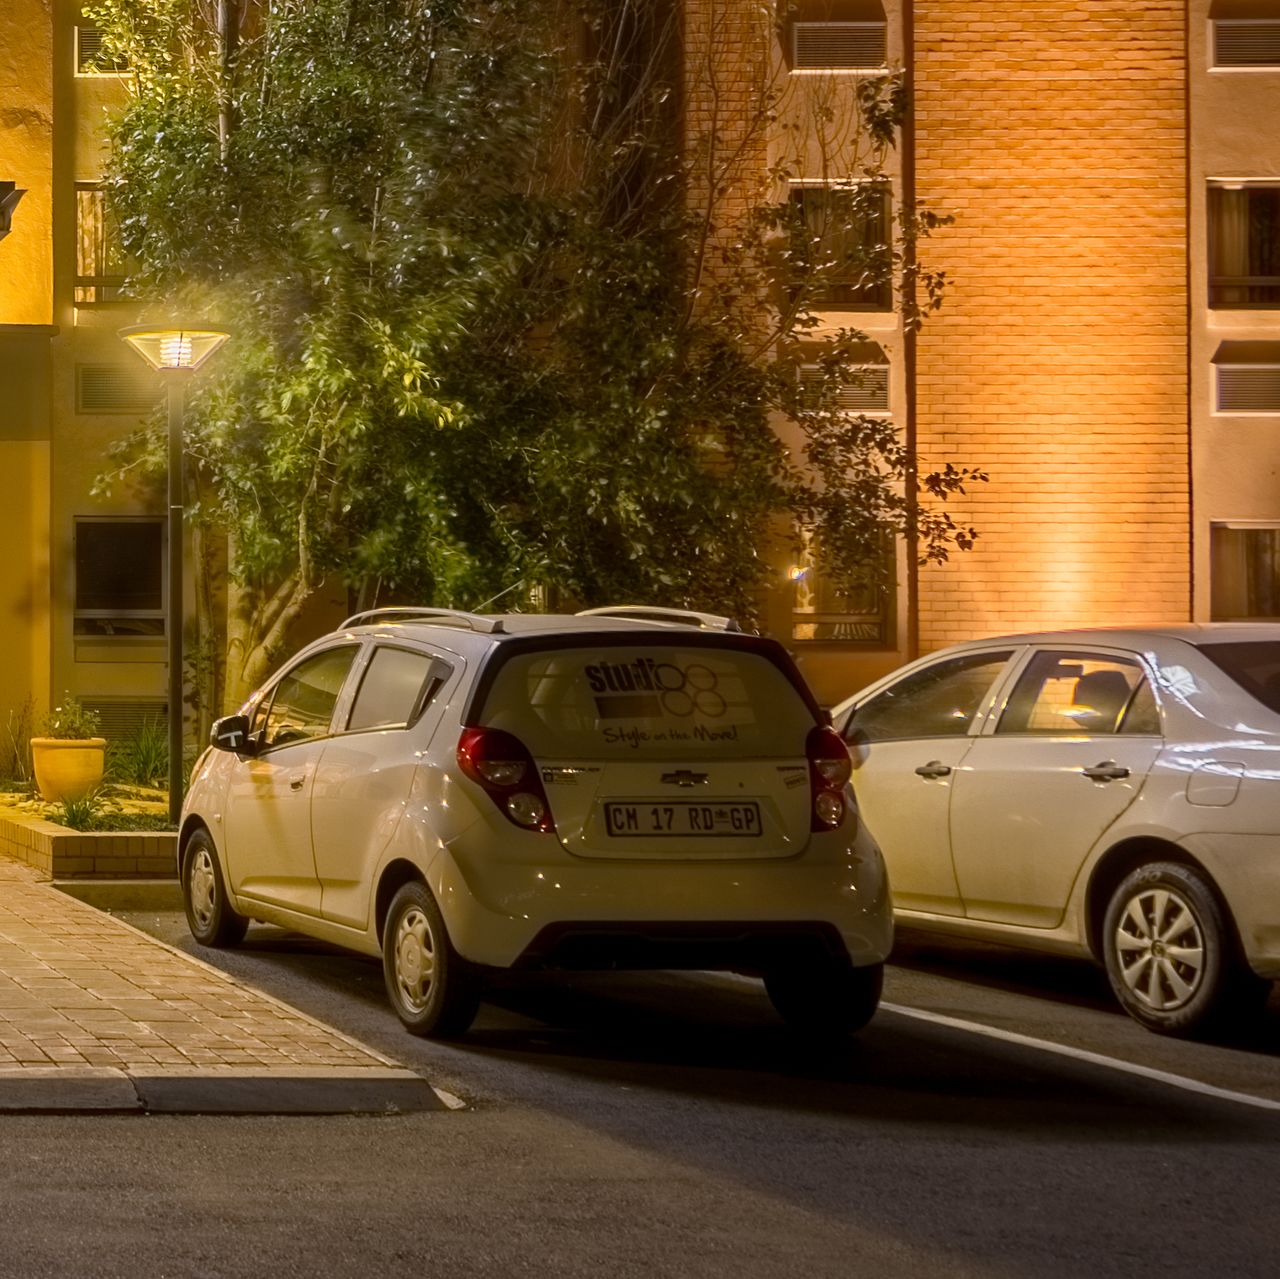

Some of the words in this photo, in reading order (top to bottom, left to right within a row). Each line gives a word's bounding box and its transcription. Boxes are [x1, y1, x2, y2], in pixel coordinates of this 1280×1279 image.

[603, 726, 650, 749] Style
[654, 732, 666, 741] on
[668, 727, 690, 741] the
[693, 724, 739, 742] Move!
[612, 807, 639, 830] CM
[651, 807, 674, 830] 17
[688, 807, 714, 830] RD
[730, 807, 755, 830] GP
